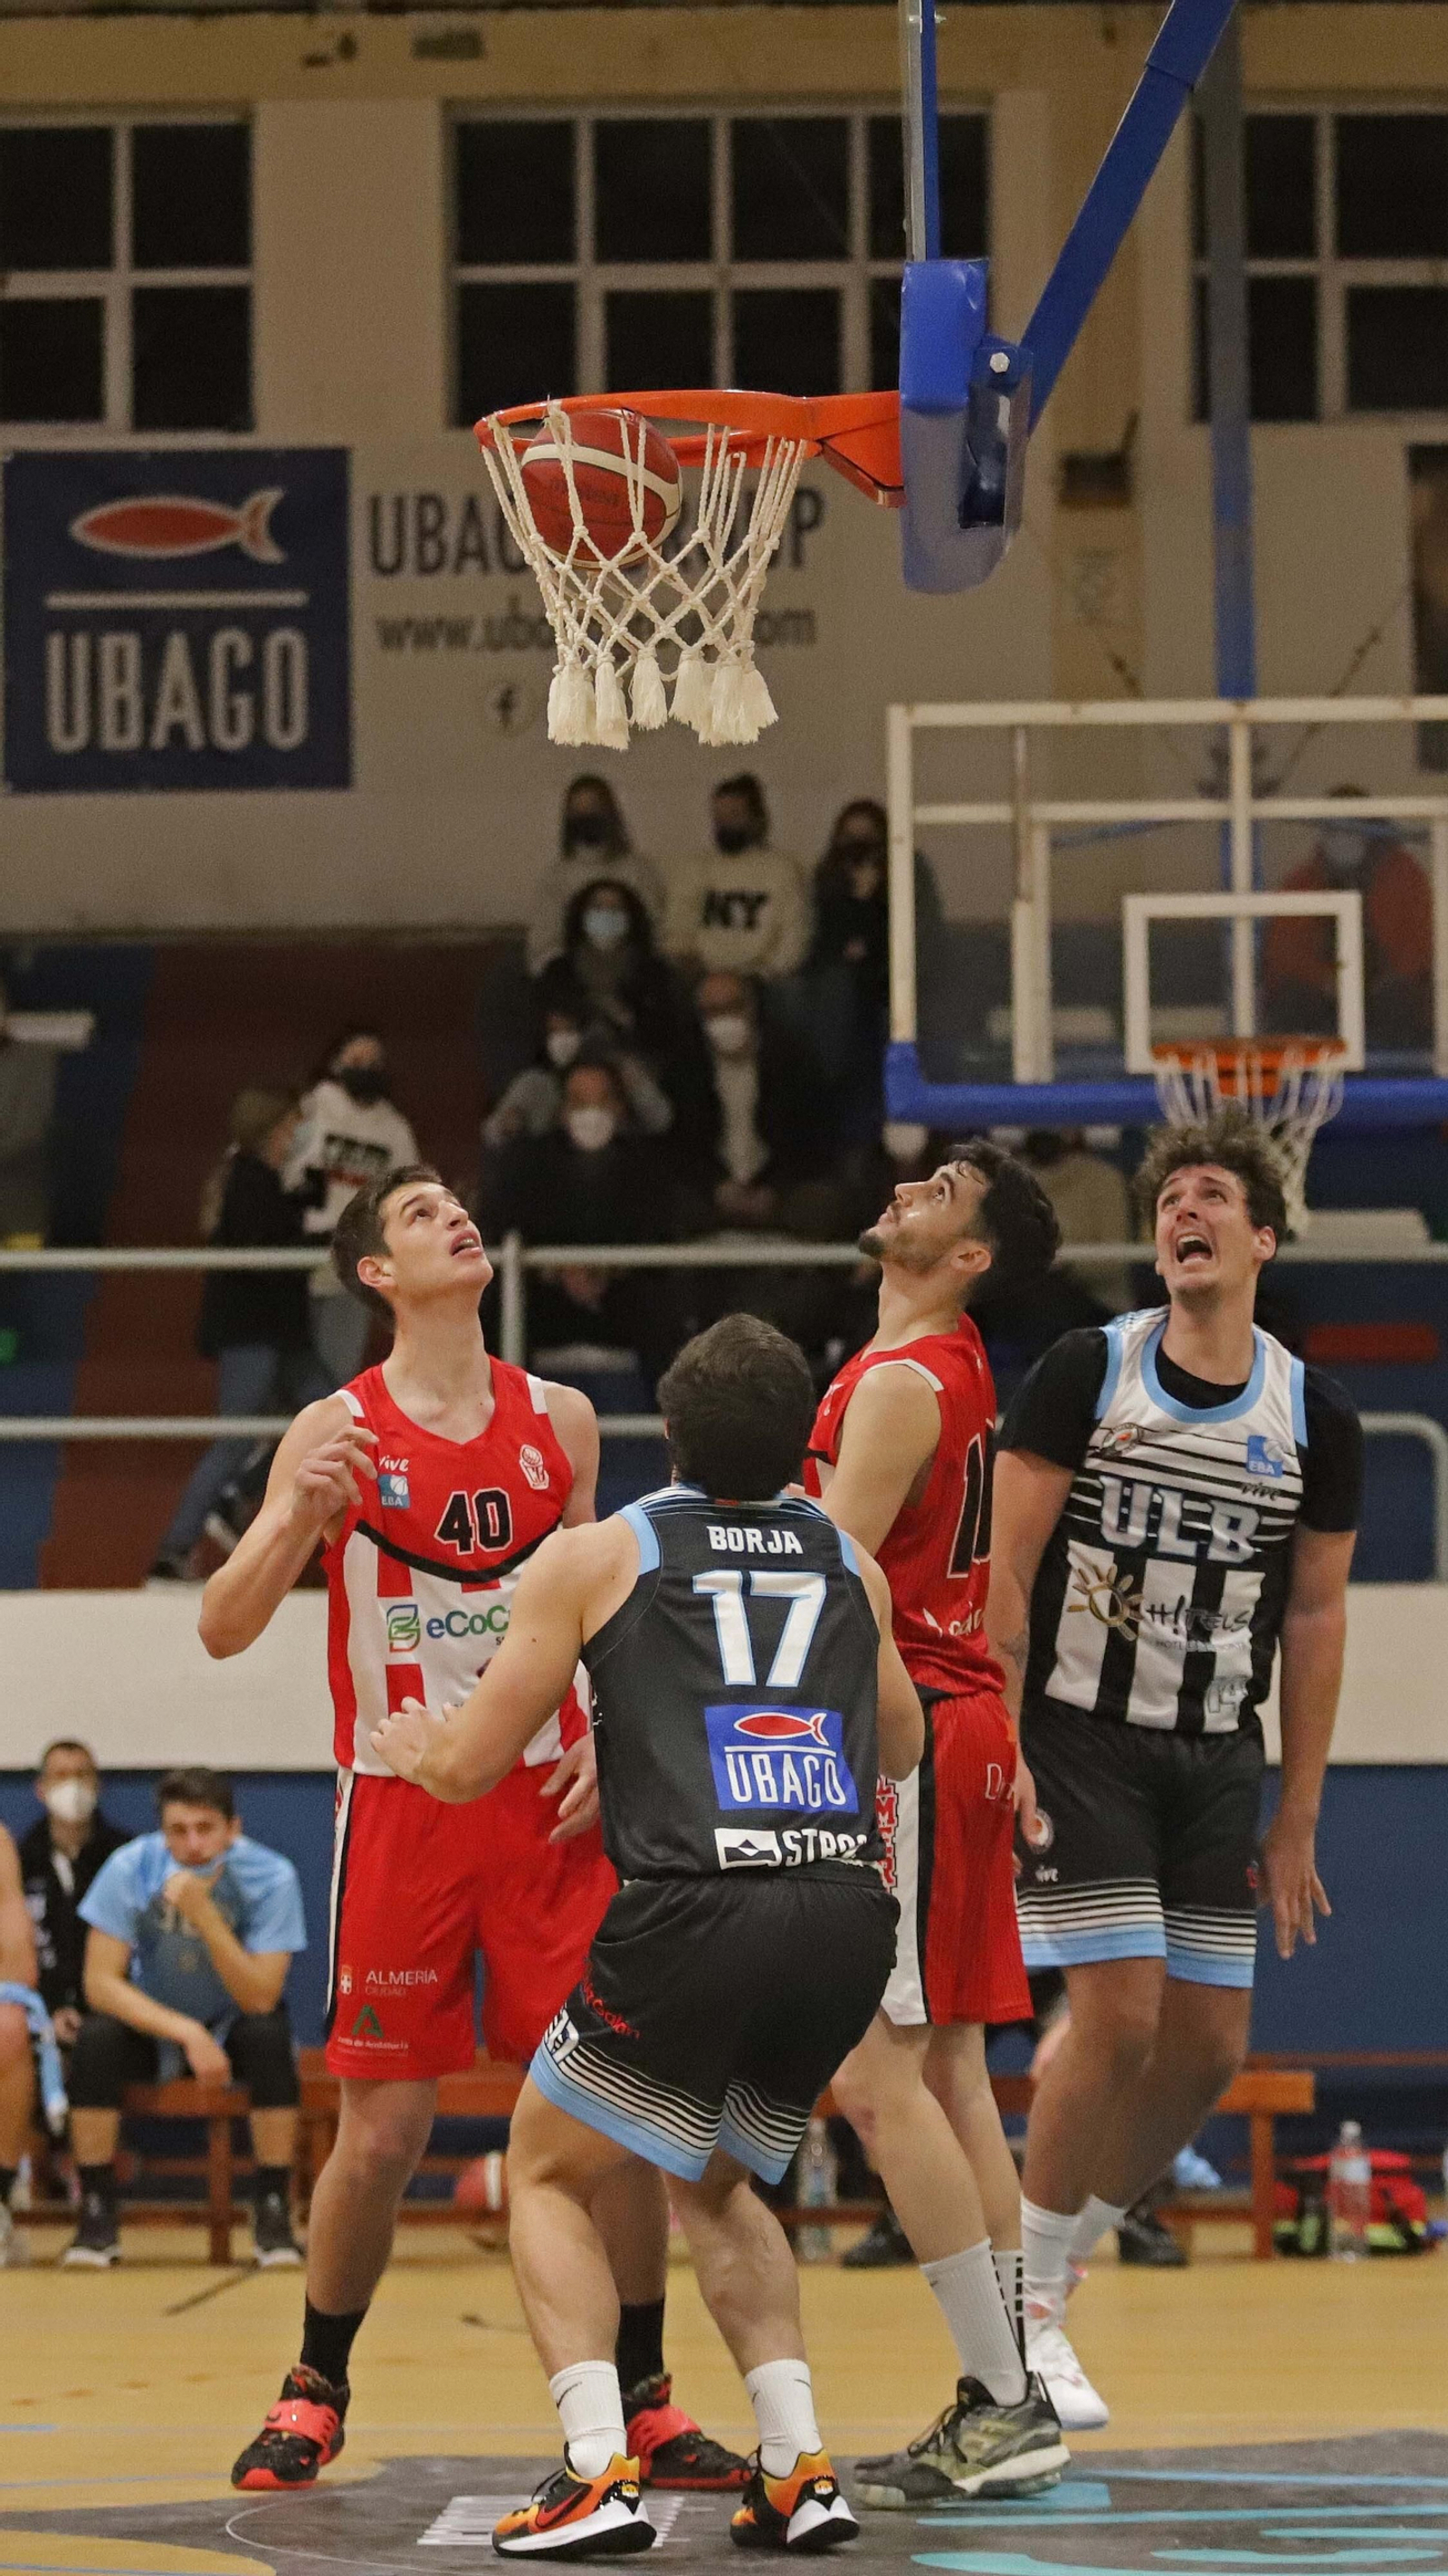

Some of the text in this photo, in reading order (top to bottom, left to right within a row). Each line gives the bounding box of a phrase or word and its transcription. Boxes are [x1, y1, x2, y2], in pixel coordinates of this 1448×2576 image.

[45, 627, 310, 755] UBAGO
[703, 889, 768, 930] NY
[1249, 1459, 1275, 1475] EBA
[433, 1488, 513, 1555] 40
[706, 1525, 804, 1554] BORJA
[1100, 1476, 1261, 1564] ULB
[425, 1604, 510, 1640] eCoC
[692, 1569, 827, 1688] 17
[725, 1752, 847, 1808] UBAGO
